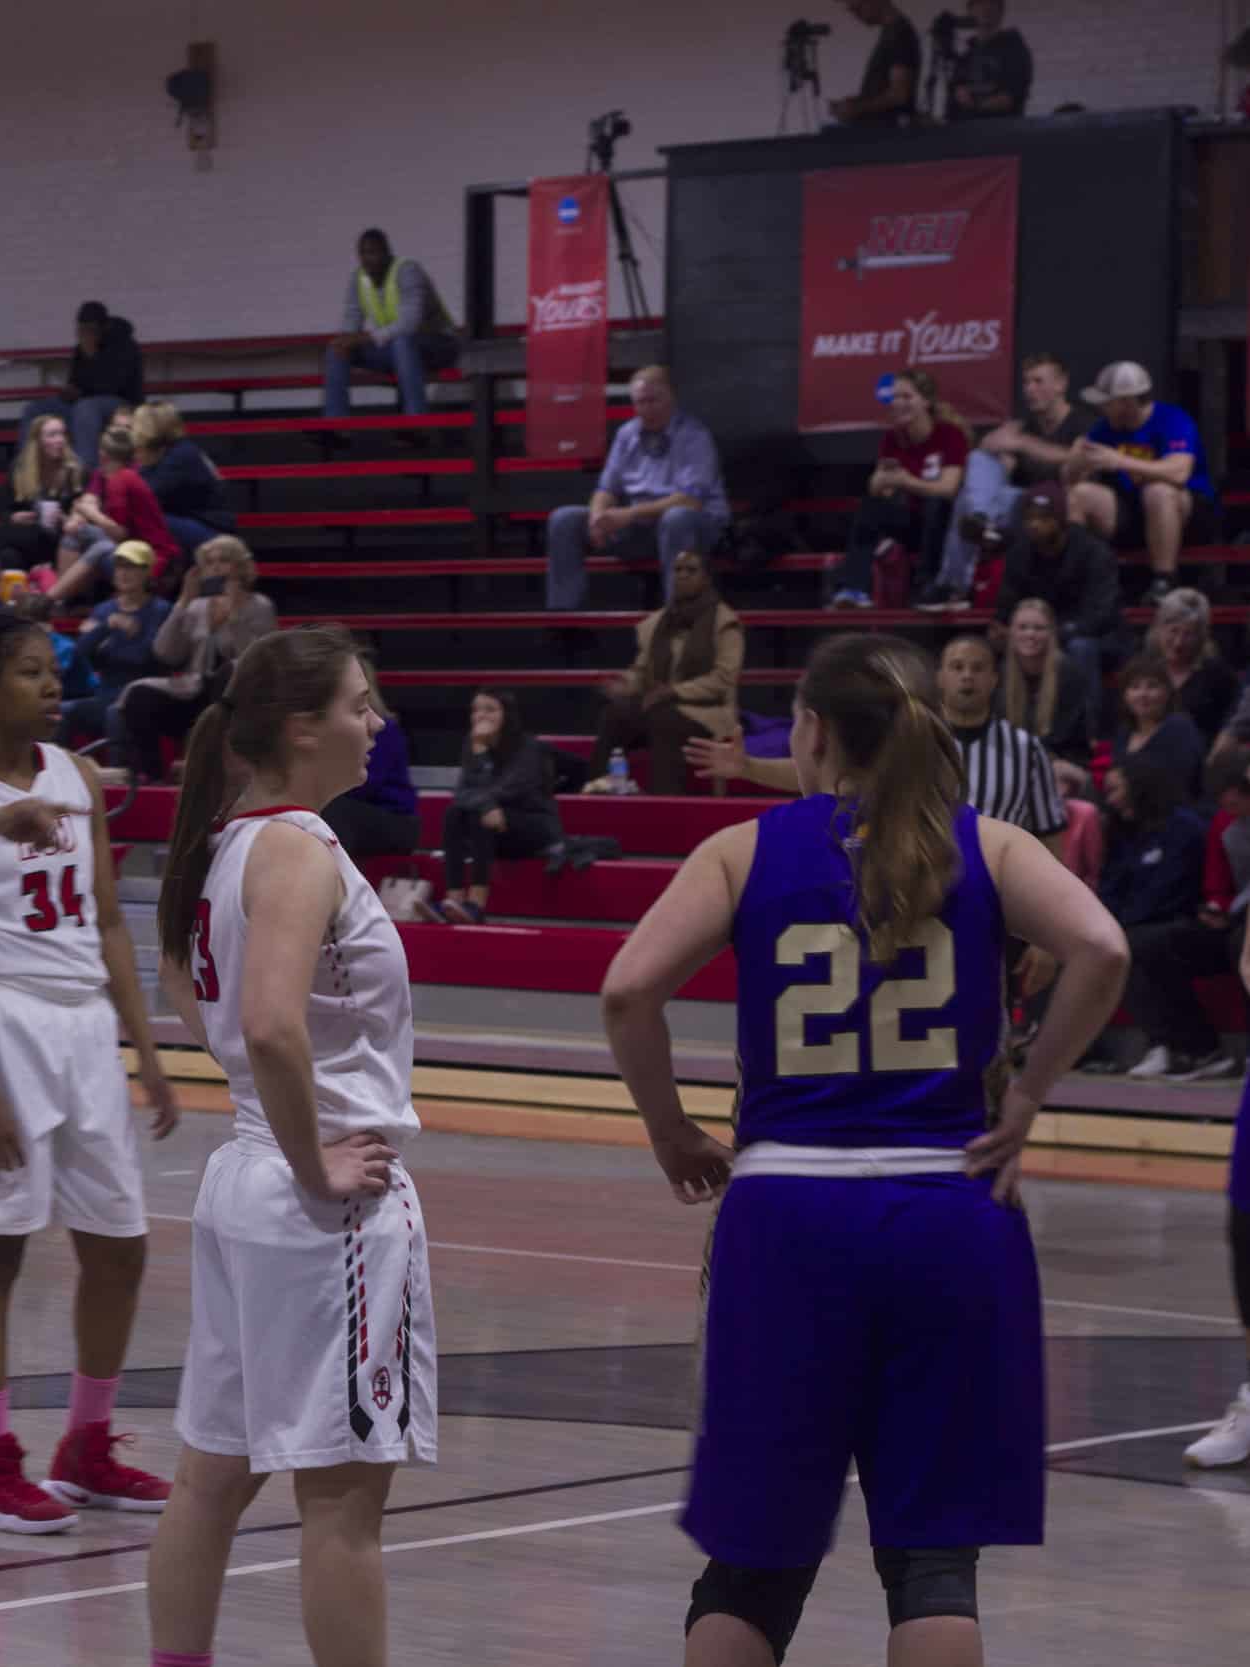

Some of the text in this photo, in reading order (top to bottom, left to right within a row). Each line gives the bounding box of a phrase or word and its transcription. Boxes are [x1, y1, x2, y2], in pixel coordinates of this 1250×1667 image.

[812, 311, 1001, 365] MAKE IT YOURS
[21, 864, 86, 931] 34
[775, 918, 958, 1076] 22
